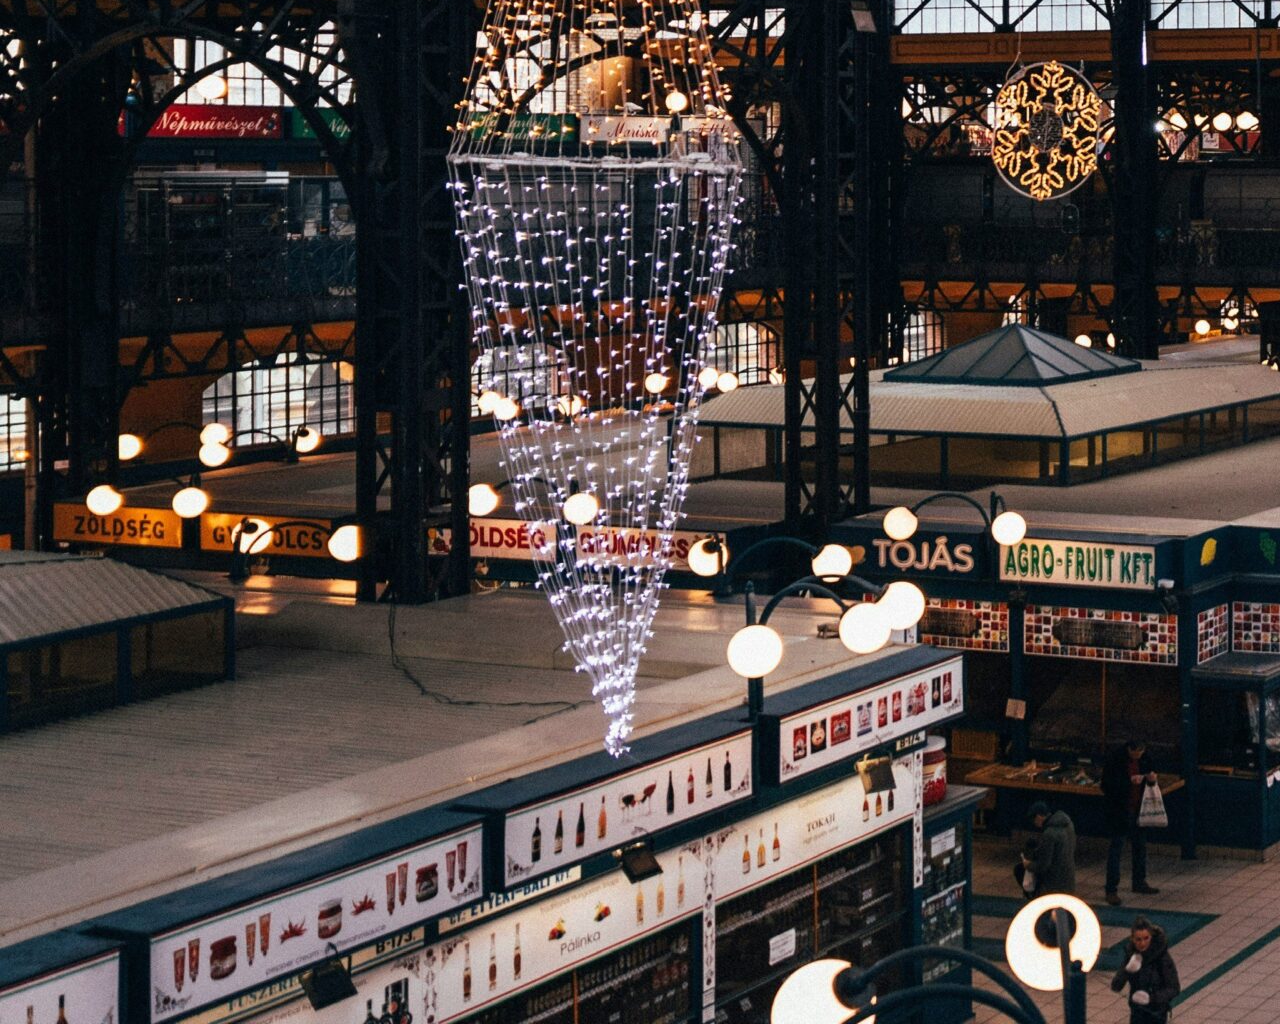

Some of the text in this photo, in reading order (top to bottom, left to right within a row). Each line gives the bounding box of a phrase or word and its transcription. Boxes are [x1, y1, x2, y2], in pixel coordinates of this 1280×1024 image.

[156, 111, 264, 137] Népművészet
[607, 121, 660, 138] Mariska
[74, 513, 165, 540] ZÖLDSÉG
[470, 522, 546, 550] ÖLDSÉG
[872, 535, 975, 573] TOJÁS
[1004, 541, 1156, 586] AGRO-FRUIT KFT.
[560, 930, 601, 956] Pálinka
